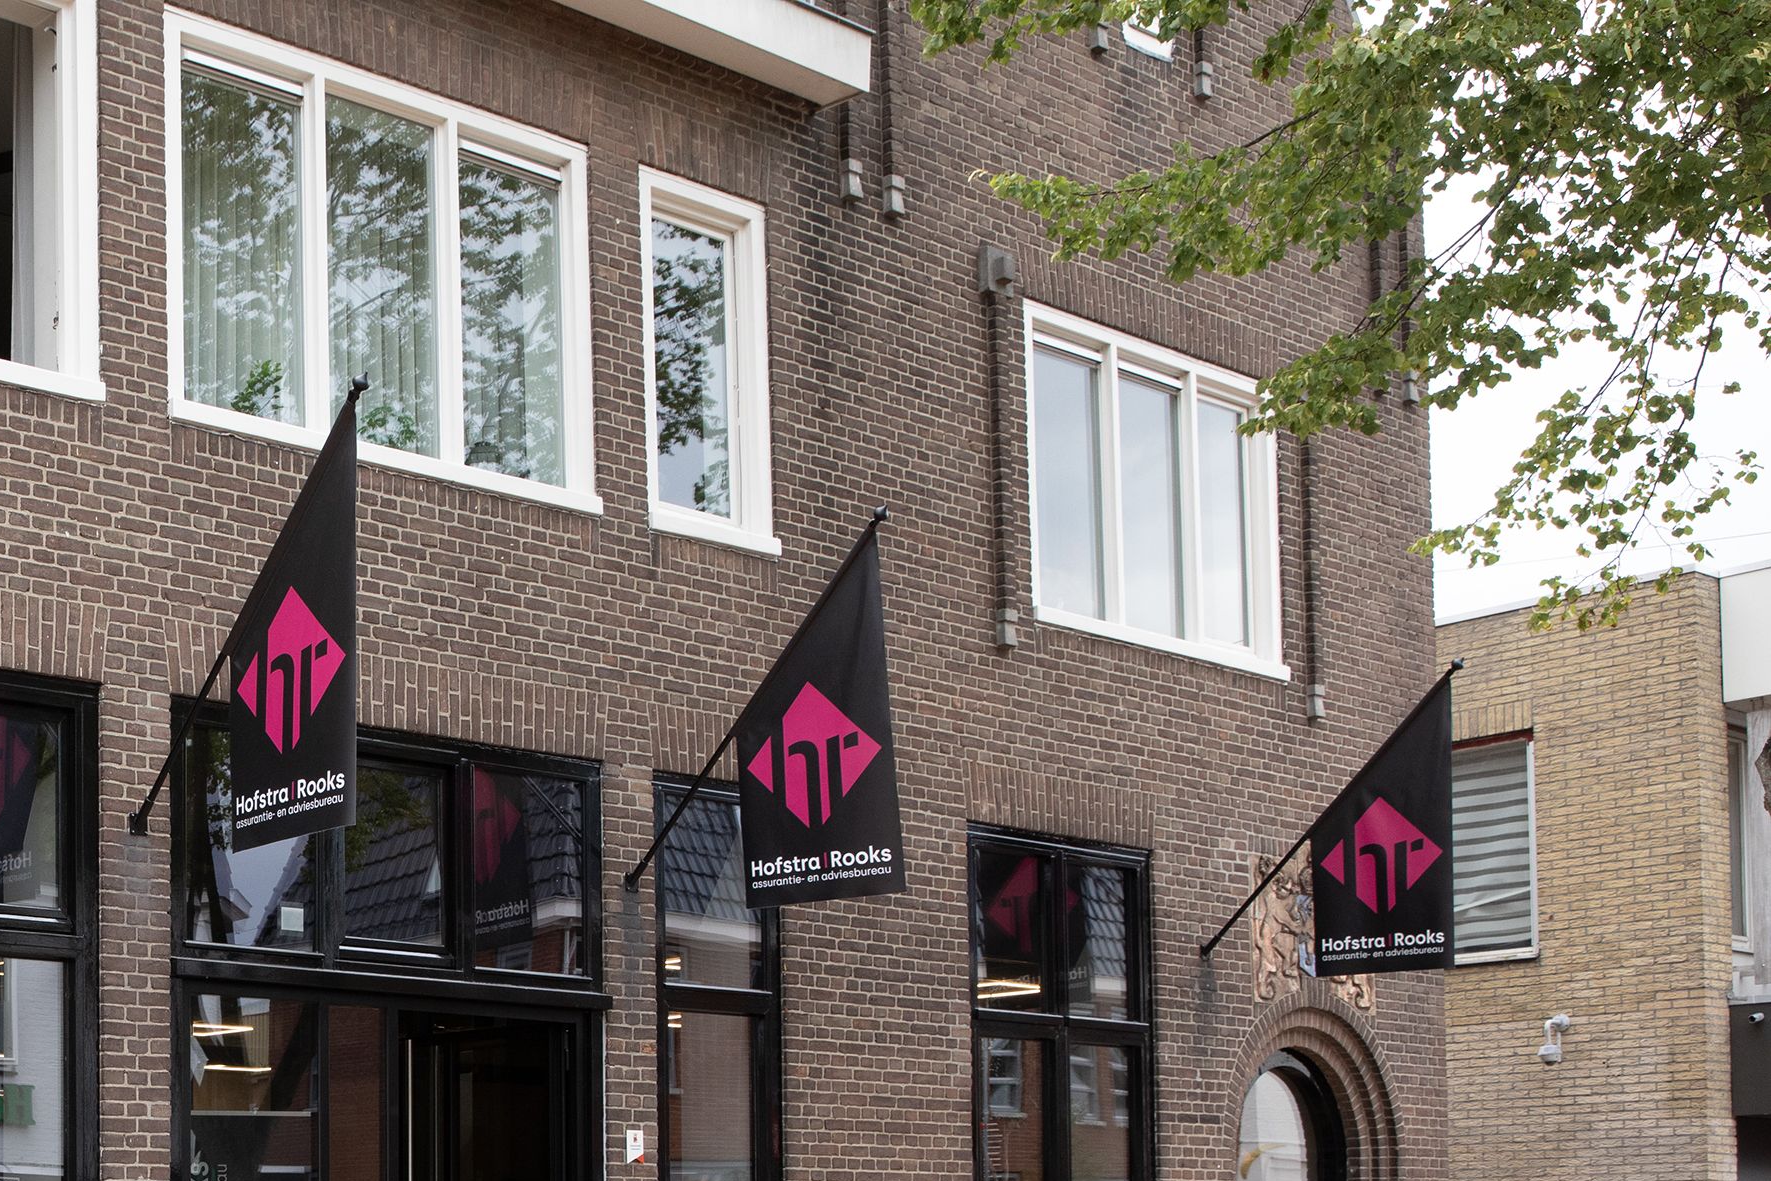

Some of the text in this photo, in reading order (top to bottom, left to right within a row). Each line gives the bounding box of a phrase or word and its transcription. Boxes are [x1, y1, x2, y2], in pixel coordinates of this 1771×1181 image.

[236, 770, 346, 816] Hofstra Rooks
[236, 794, 344, 829] assurantie- en adviesbureau
[751, 845, 892, 878] Hofstra Rooks
[752, 866, 892, 889] assurantie- en adviesbureau
[1322, 929, 1445, 952] Hofstra Rooks
[1322, 951, 1371, 962] assurantie-
[1385, 945, 1444, 957] adviesbureau
